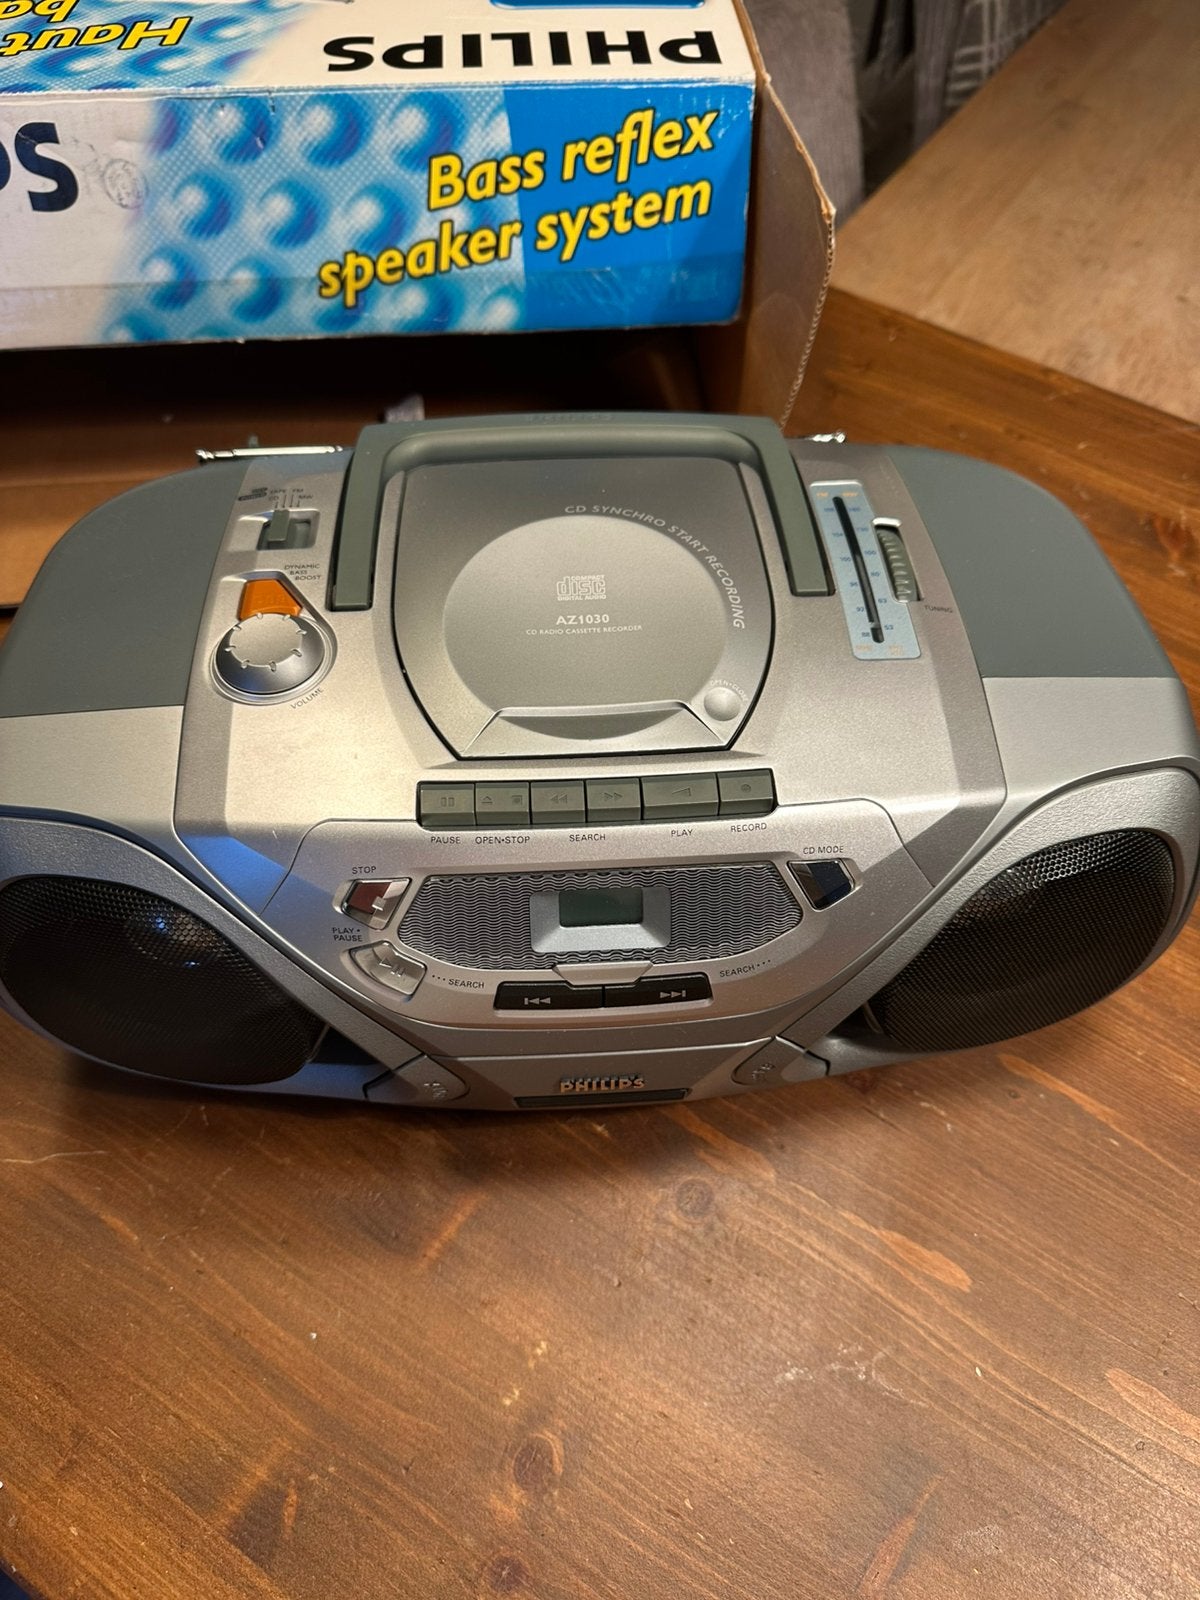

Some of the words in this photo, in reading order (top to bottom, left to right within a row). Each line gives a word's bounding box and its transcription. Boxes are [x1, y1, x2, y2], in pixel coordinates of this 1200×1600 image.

[0, 16, 193, 56] Haut
[323, 30, 722, 71] PHILIPS
[428, 148, 545, 211] Bass
[562, 107, 719, 183] reflex
[0, 122, 78, 212] S
[318, 217, 523, 309] speaker
[535, 179, 713, 262] system
[564, 504, 587, 514] CD
[591, 504, 666, 528] SYNCHRO
[667, 524, 709, 552] START
[704, 554, 745, 630] RECORDING
[571, 574, 605, 582] COMPACT
[556, 576, 606, 596] disc
[556, 614, 609, 625] AZ1030
[565, 627, 601, 635] CASSETTE
[603, 625, 643, 633] RECORDER
[290, 687, 325, 709] VOLUME
[670, 828, 694, 837] PLAY
[730, 822, 767, 833] RECORD
[430, 836, 461, 844] PAUSE
[569, 833, 606, 842] SEARCH
[803, 846, 815, 855] CD
[817, 845, 844, 854] MODE
[352, 866, 377, 874] STOP
[333, 934, 363, 942] PAUSE
[719, 964, 756, 978] SEARCH
[448, 978, 485, 989] SEARCH
[560, 1075, 646, 1093] PHILIPS
